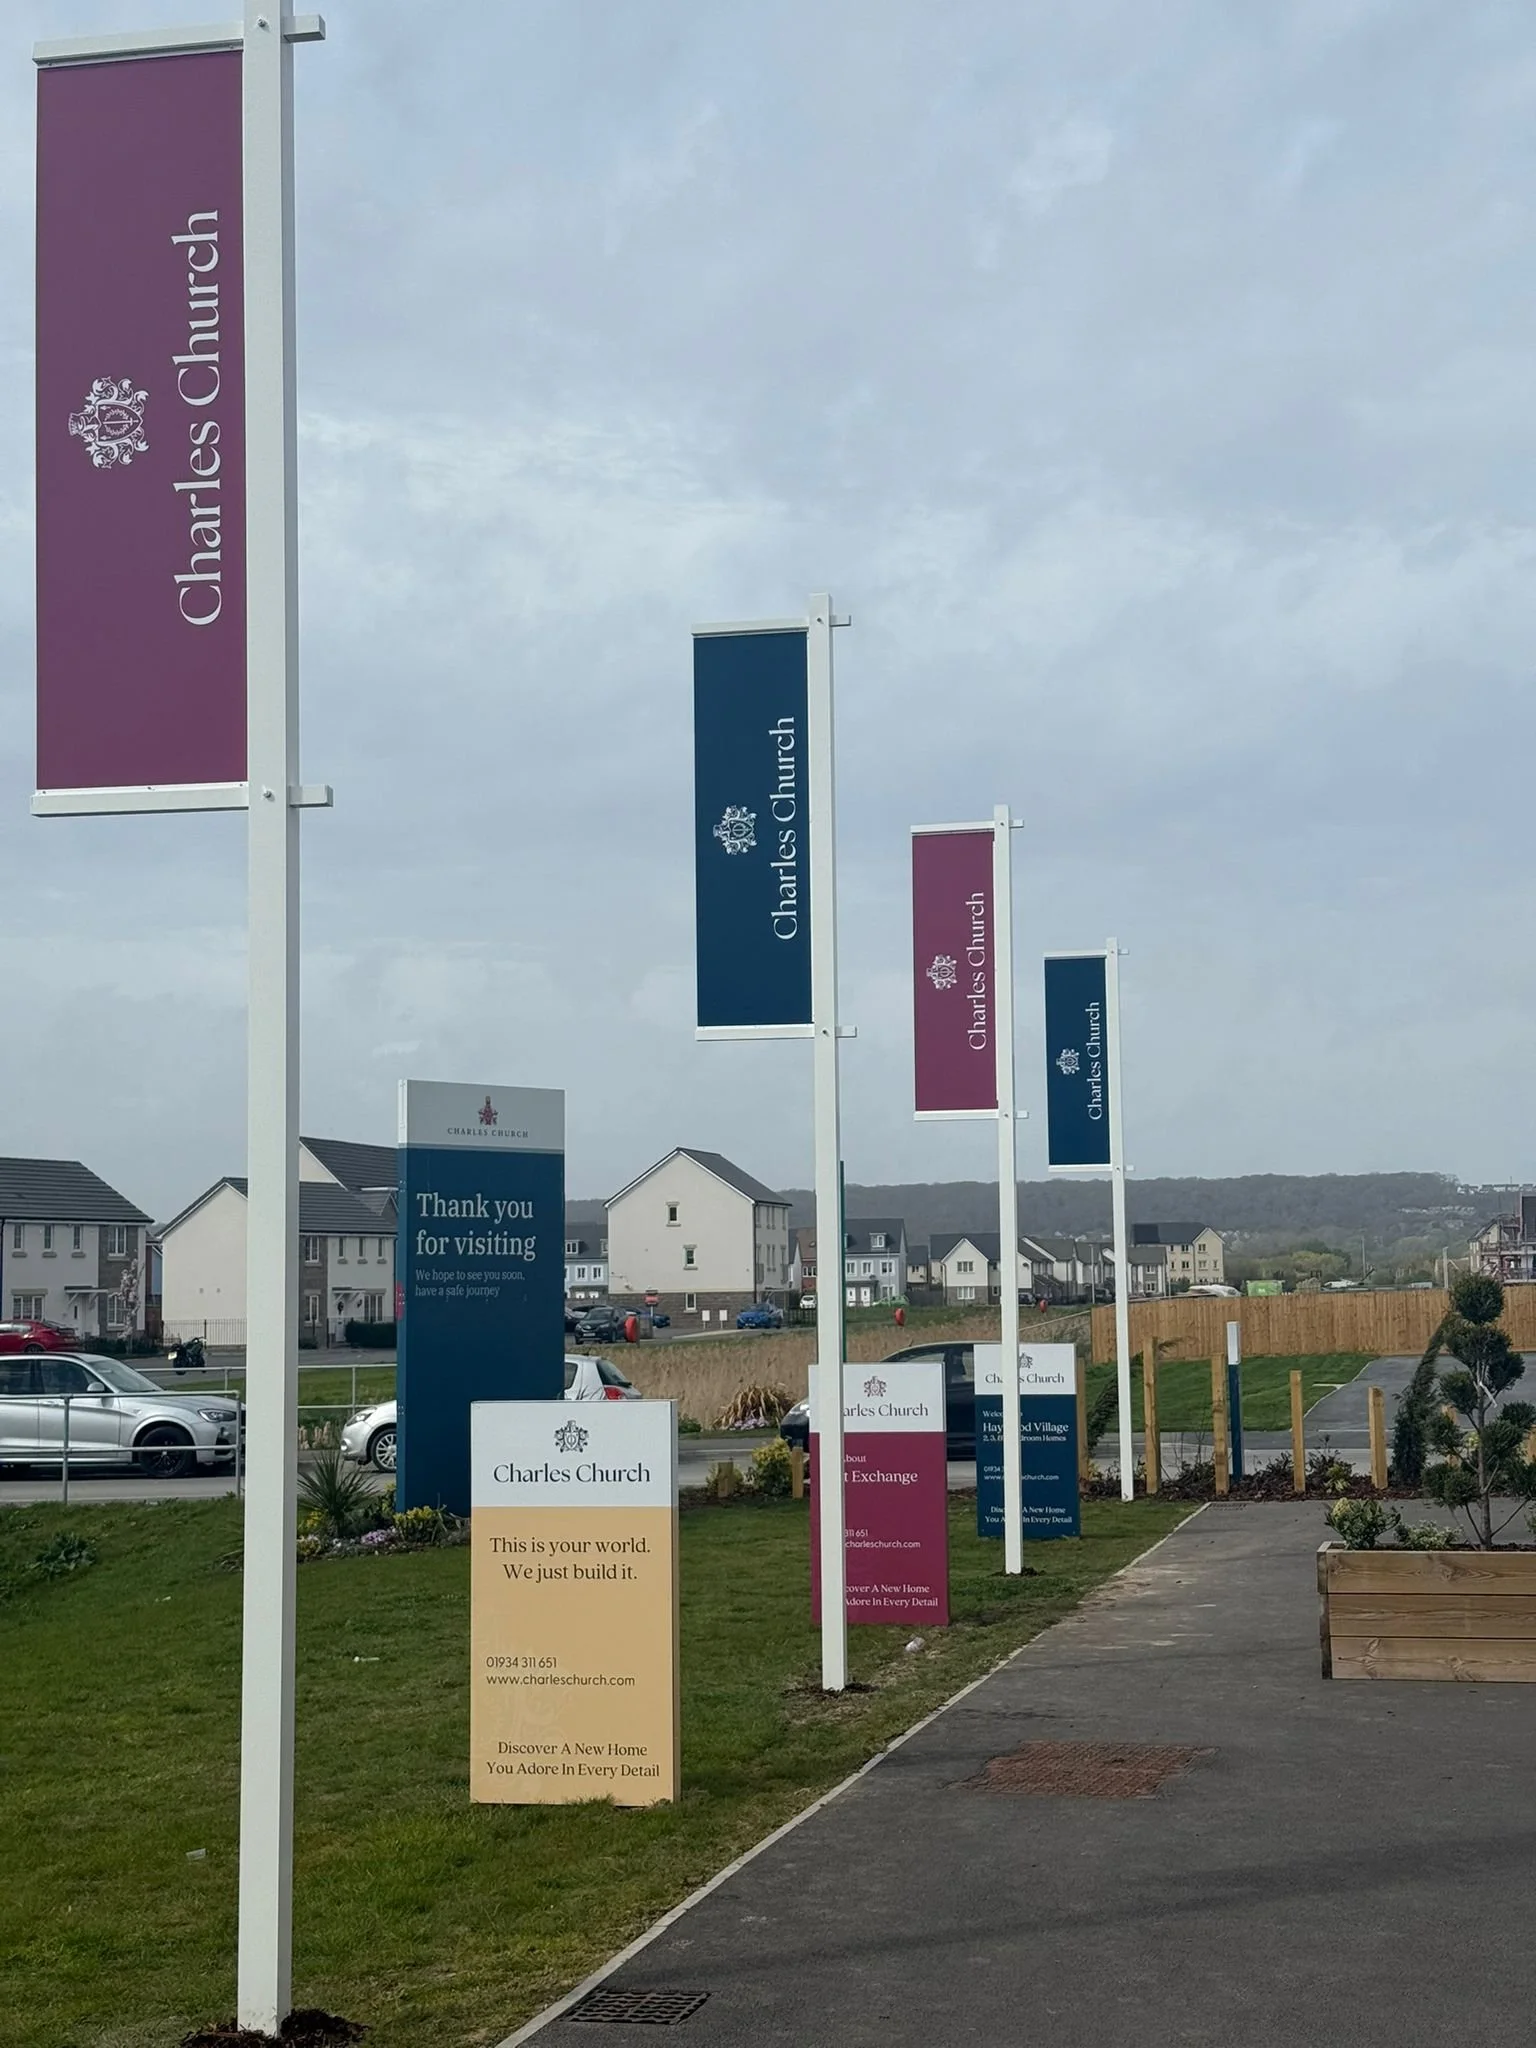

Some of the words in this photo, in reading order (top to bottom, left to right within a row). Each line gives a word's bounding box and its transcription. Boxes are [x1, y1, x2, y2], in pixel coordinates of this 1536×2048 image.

[170, 210, 221, 406] Church
[172, 422, 222, 625] Charles
[768, 716, 796, 822] Church
[770, 829, 798, 940] Charles
[965, 891, 985, 967] Church
[966, 972, 987, 1050] Charles
[1085, 1001, 1101, 1058] Church
[1086, 1064, 1102, 1120] Charles
[447, 1127, 489, 1137] CHARLES
[491, 1129, 529, 1138] CHURCH
[416, 1192, 490, 1218] Thank
[494, 1200, 534, 1224] you
[416, 1229, 449, 1255] for
[454, 1230, 536, 1261] visiting
[415, 1269, 430, 1280] We
[432, 1269, 455, 1282] hope
[456, 1270, 465, 1280] to
[466, 1271, 483, 1280] see
[483, 1271, 500, 1282] you
[415, 1284, 437, 1296] have
[438, 1287, 444, 1296] a
[445, 1284, 465, 1296] safe
[465, 1285, 500, 1298] journey
[1027, 1373, 1065, 1384] Church
[843, 1403, 875, 1417] arles
[878, 1402, 929, 1417] Church
[1033, 1422, 1070, 1435] Village
[493, 1463, 571, 1483] Charles
[576, 1463, 651, 1483] Church
[852, 1470, 918, 1485] Exchange
[1045, 1506, 1066, 1514] Home
[985, 1515, 1000, 1523] You
[1031, 1516, 1051, 1525] Every
[855, 1529, 869, 1538] 651
[489, 1537, 527, 1553] This
[531, 1537, 545, 1553] is
[549, 1541, 591, 1557] your
[596, 1537, 651, 1553] world.
[845, 1540, 921, 1549] charleschurch.com
[503, 1564, 533, 1579] We
[535, 1564, 569, 1583] just
[573, 1564, 617, 1580] build
[621, 1564, 638, 1580] it.
[871, 1584, 880, 1593] A
[881, 1584, 901, 1593] New
[902, 1585, 930, 1593] Home
[872, 1598, 882, 1606] In
[883, 1598, 910, 1608] Every
[911, 1598, 938, 1607] Detail
[486, 1656, 519, 1668] 01934
[521, 1656, 536, 1668] 311
[538, 1657, 557, 1669] 651
[486, 1674, 635, 1687] www.charleschurch.com
[498, 1741, 558, 1755] Discover
[560, 1743, 571, 1755] A
[574, 1743, 604, 1756] New
[608, 1743, 648, 1756] Home
[486, 1761, 513, 1775] You
[516, 1763, 559, 1775] Adore
[561, 1763, 575, 1776] In
[578, 1763, 618, 1779] Every
[620, 1764, 660, 1777] Detail
